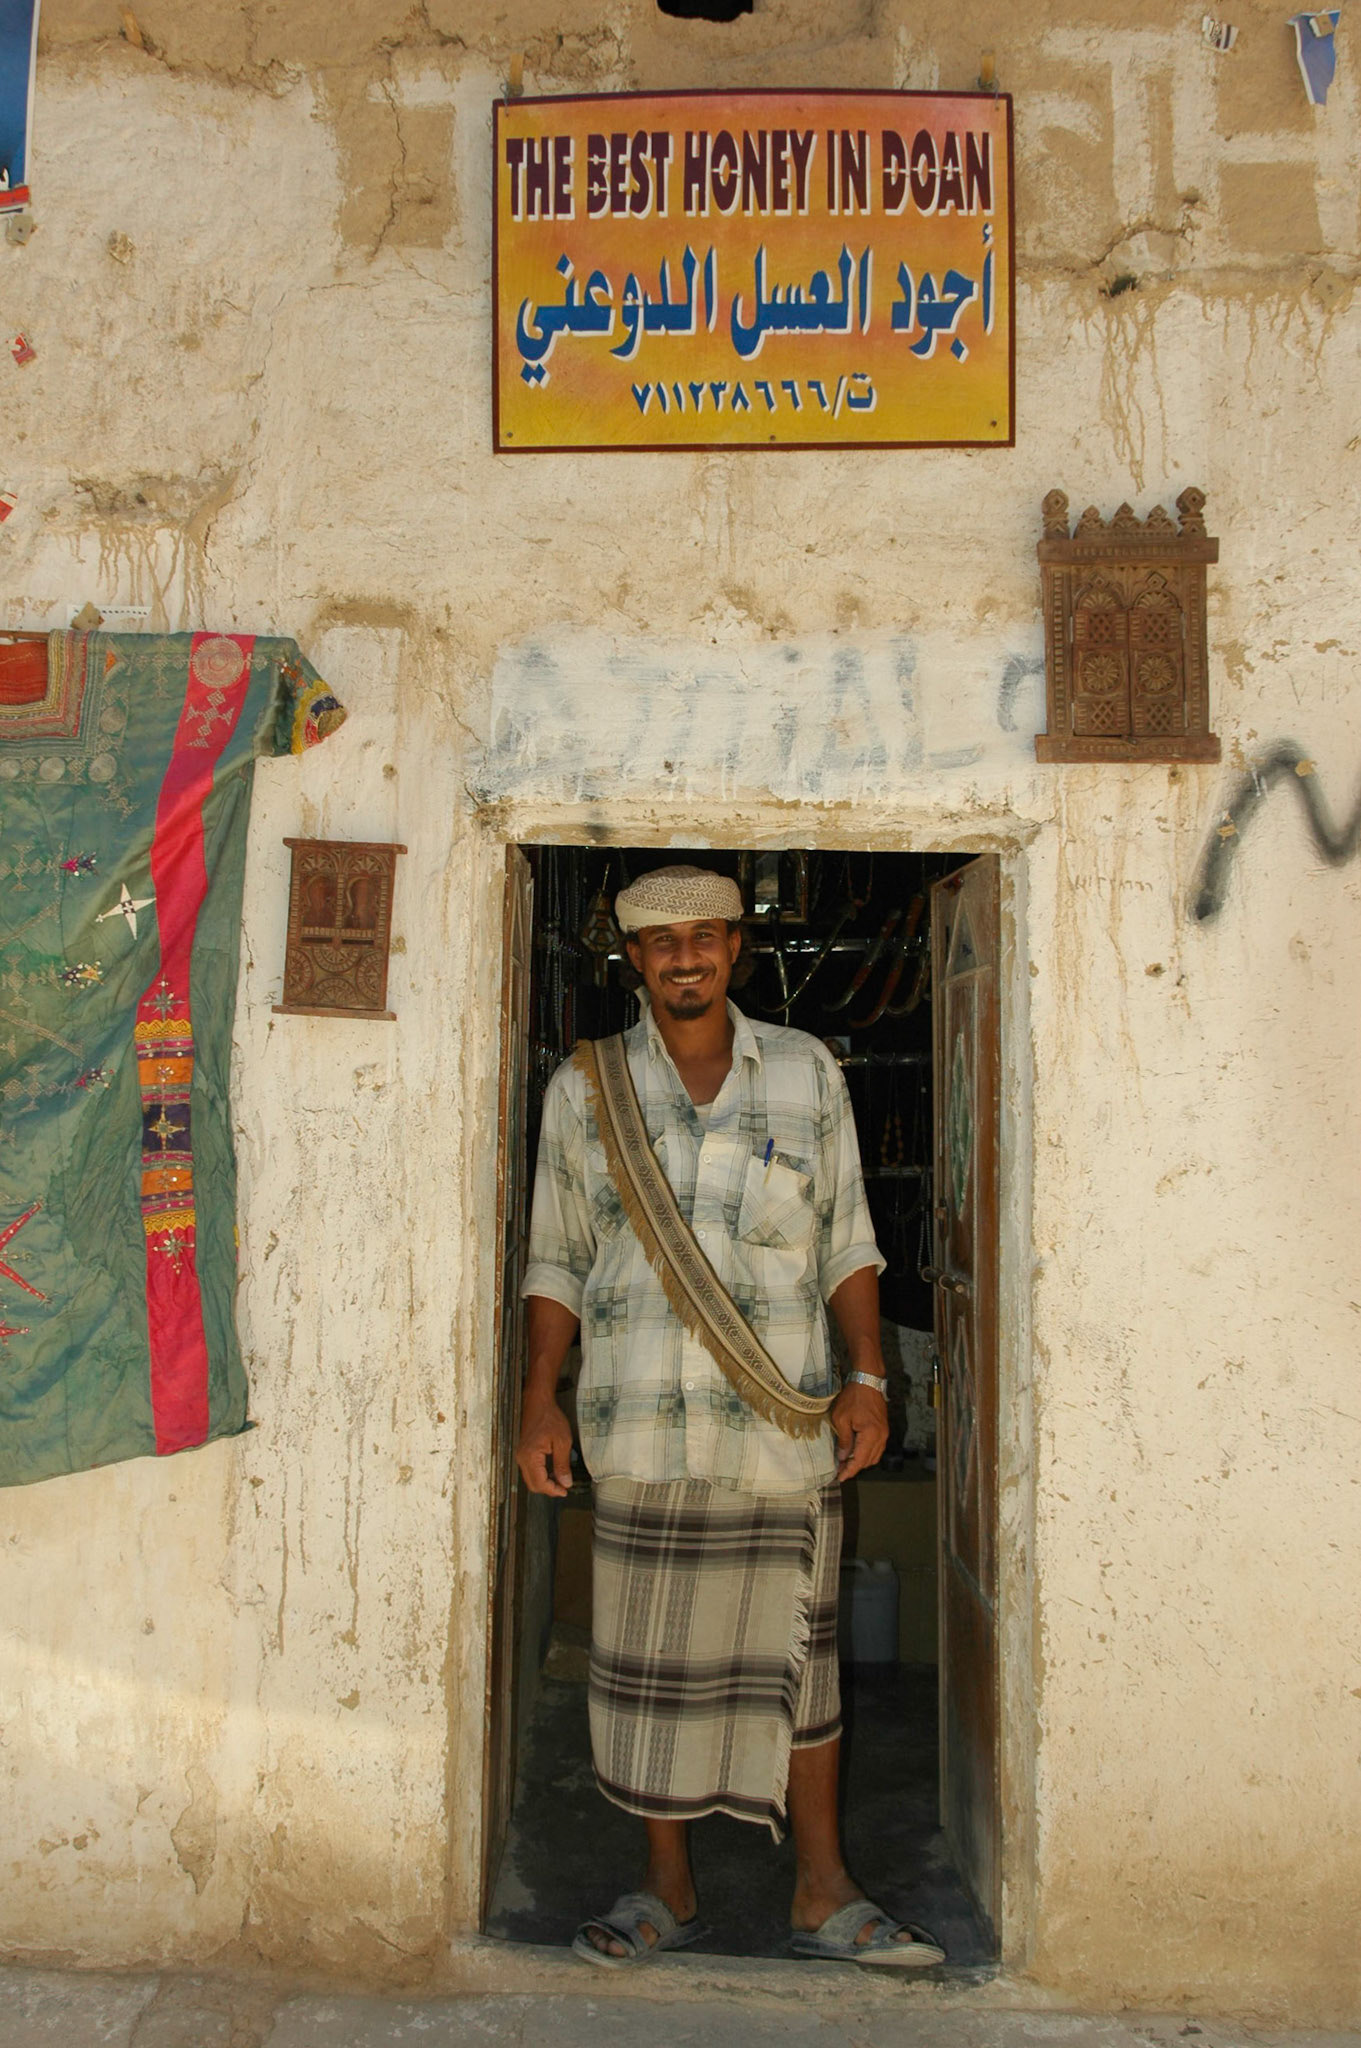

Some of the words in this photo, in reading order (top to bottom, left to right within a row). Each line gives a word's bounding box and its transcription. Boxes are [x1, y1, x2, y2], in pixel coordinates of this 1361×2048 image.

[505, 134, 575, 221] THE
[586, 130, 674, 220] BEST
[683, 129, 817, 218] HONEY
[826, 129, 869, 217] IN
[881, 129, 994, 217] DOAN
[515, 242, 717, 388] الدوعني
[730, 242, 872, 360] العسل
[891, 224, 994, 363] أجود
